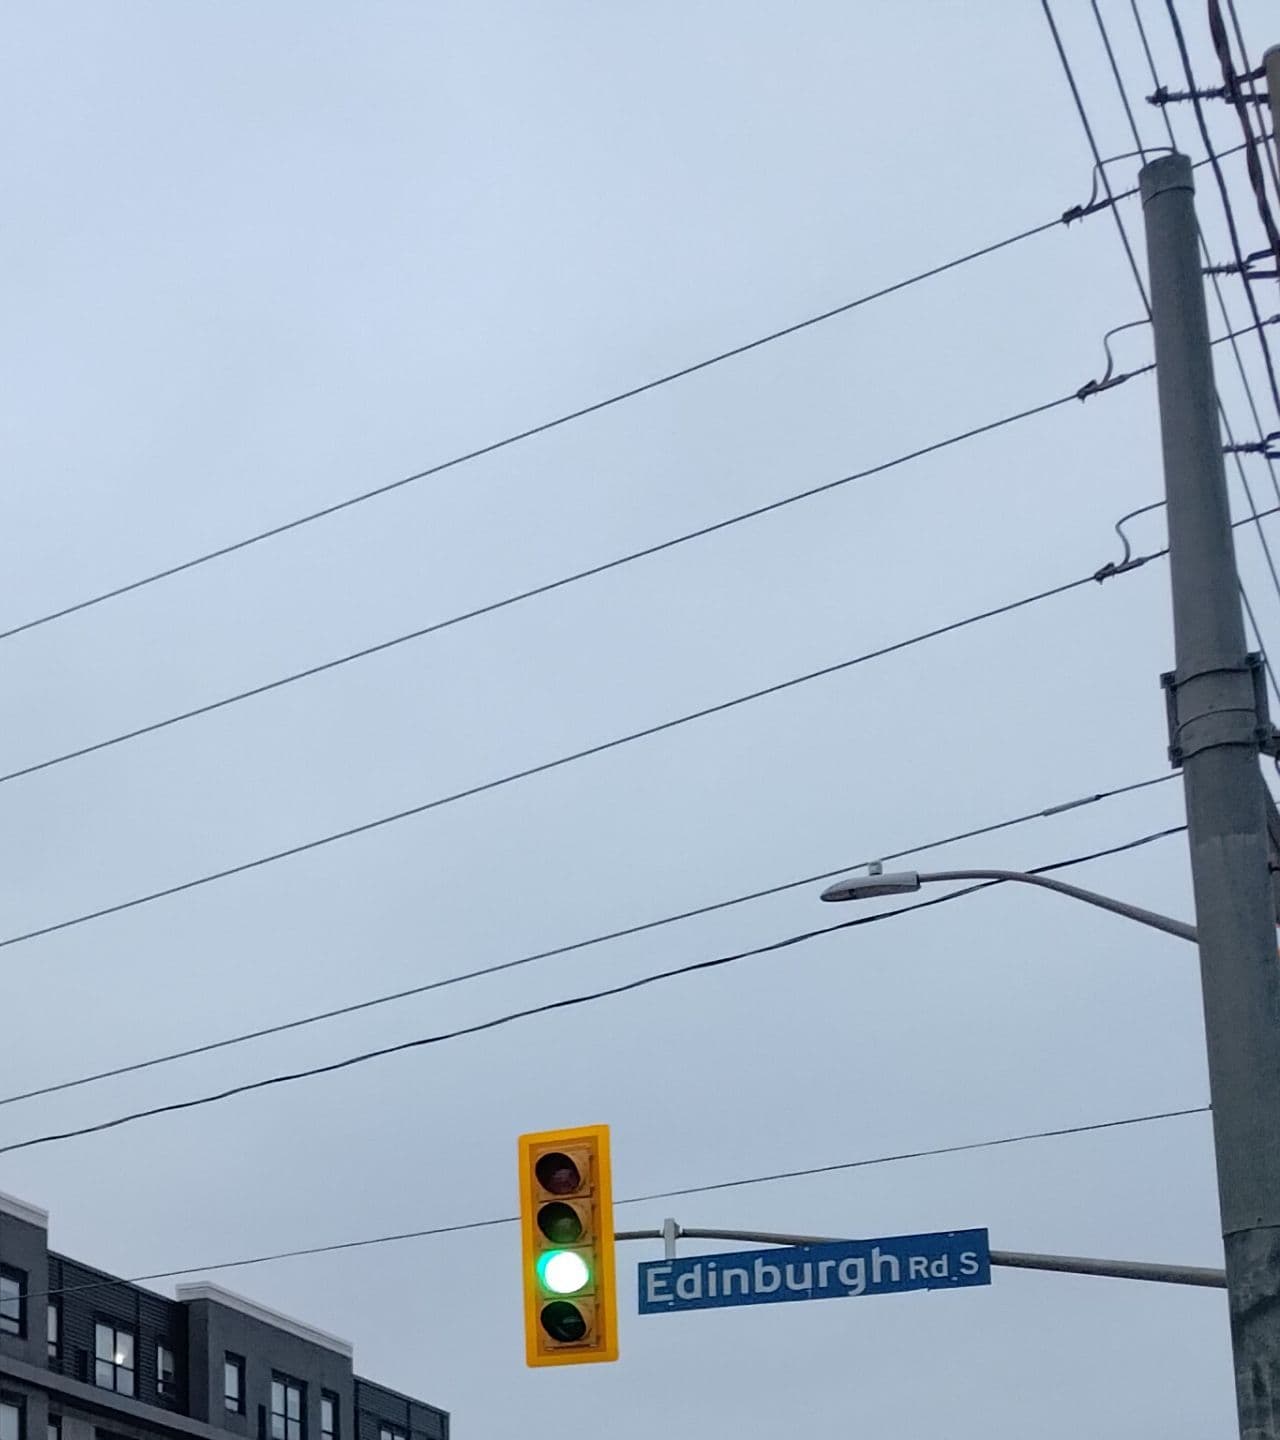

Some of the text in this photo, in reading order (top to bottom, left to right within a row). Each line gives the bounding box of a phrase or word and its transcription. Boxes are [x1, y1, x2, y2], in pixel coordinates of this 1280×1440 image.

[646, 1246, 980, 1303] Edinburgh Rd S
